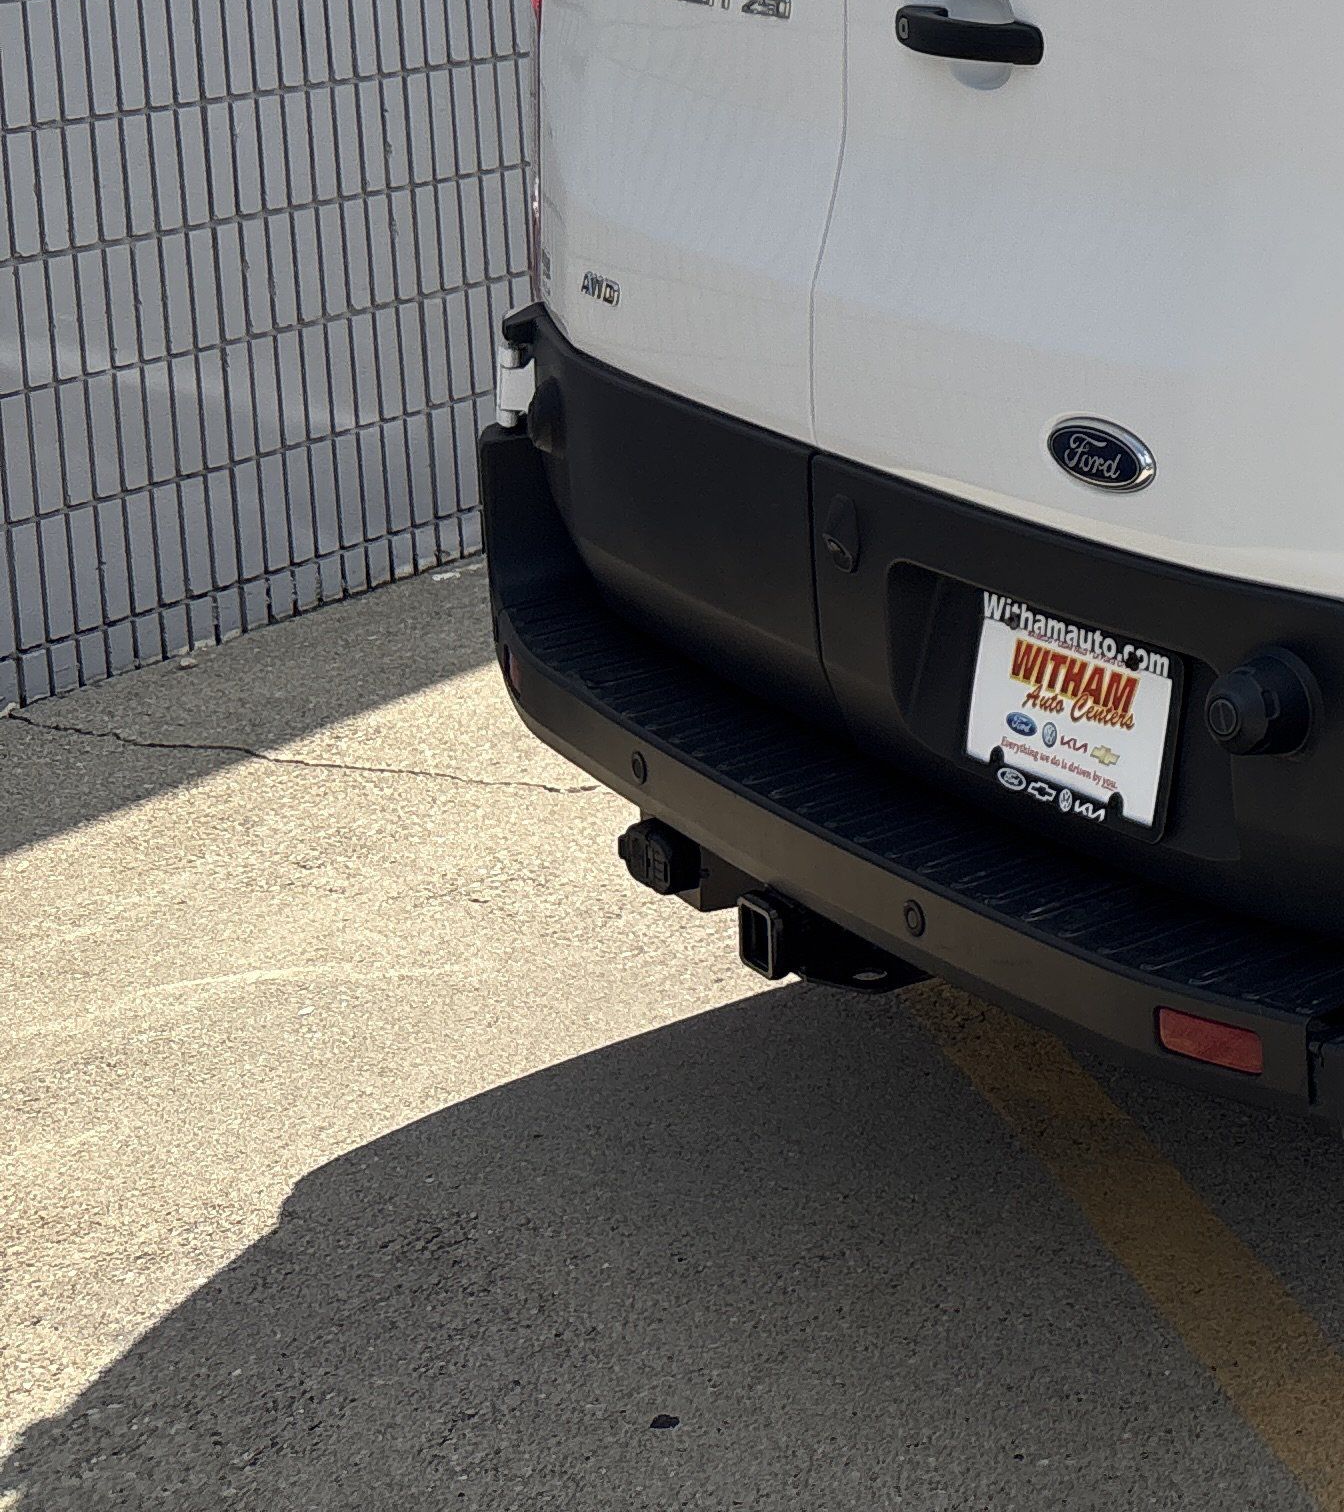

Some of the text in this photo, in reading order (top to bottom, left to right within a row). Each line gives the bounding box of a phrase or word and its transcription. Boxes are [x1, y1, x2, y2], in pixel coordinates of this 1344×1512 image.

[1063, 433, 1123, 480] Ford
[1010, 638, 1141, 713] WITHAM
[1022, 685, 1135, 730] Auto Centers
[1000, 736, 1039, 761] Everything
